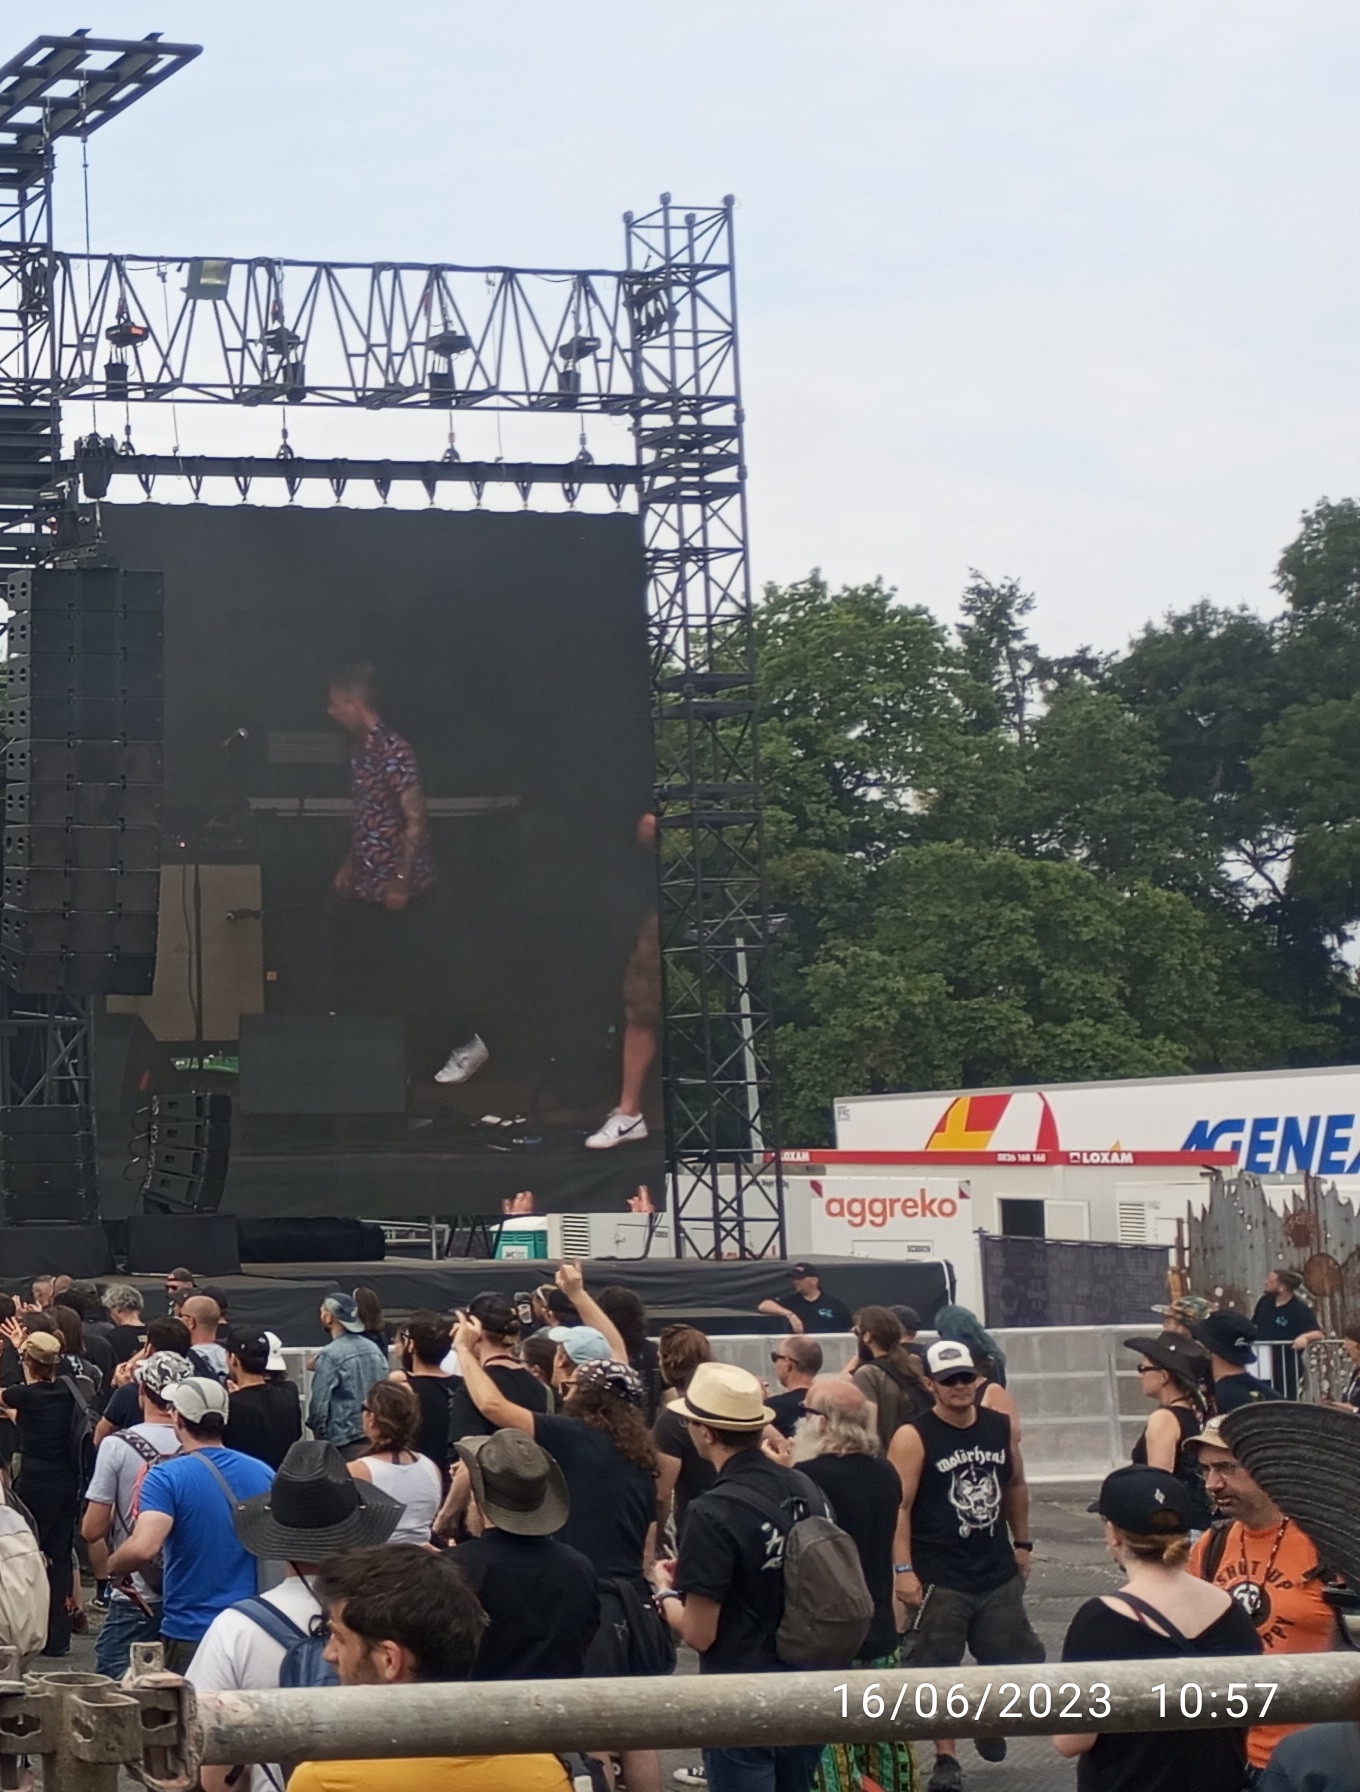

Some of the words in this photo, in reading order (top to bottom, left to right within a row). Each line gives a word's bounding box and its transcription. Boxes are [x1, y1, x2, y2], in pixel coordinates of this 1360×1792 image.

[1082, 1152, 1134, 1164] LOXAM
[1181, 1113, 1360, 1175] AGENE
[825, 1188, 957, 1228] aggreko
[1217, 1561, 1260, 1586] SHUT
[1265, 1568, 1293, 1591] UP
[1262, 1615, 1295, 1649] PPY
